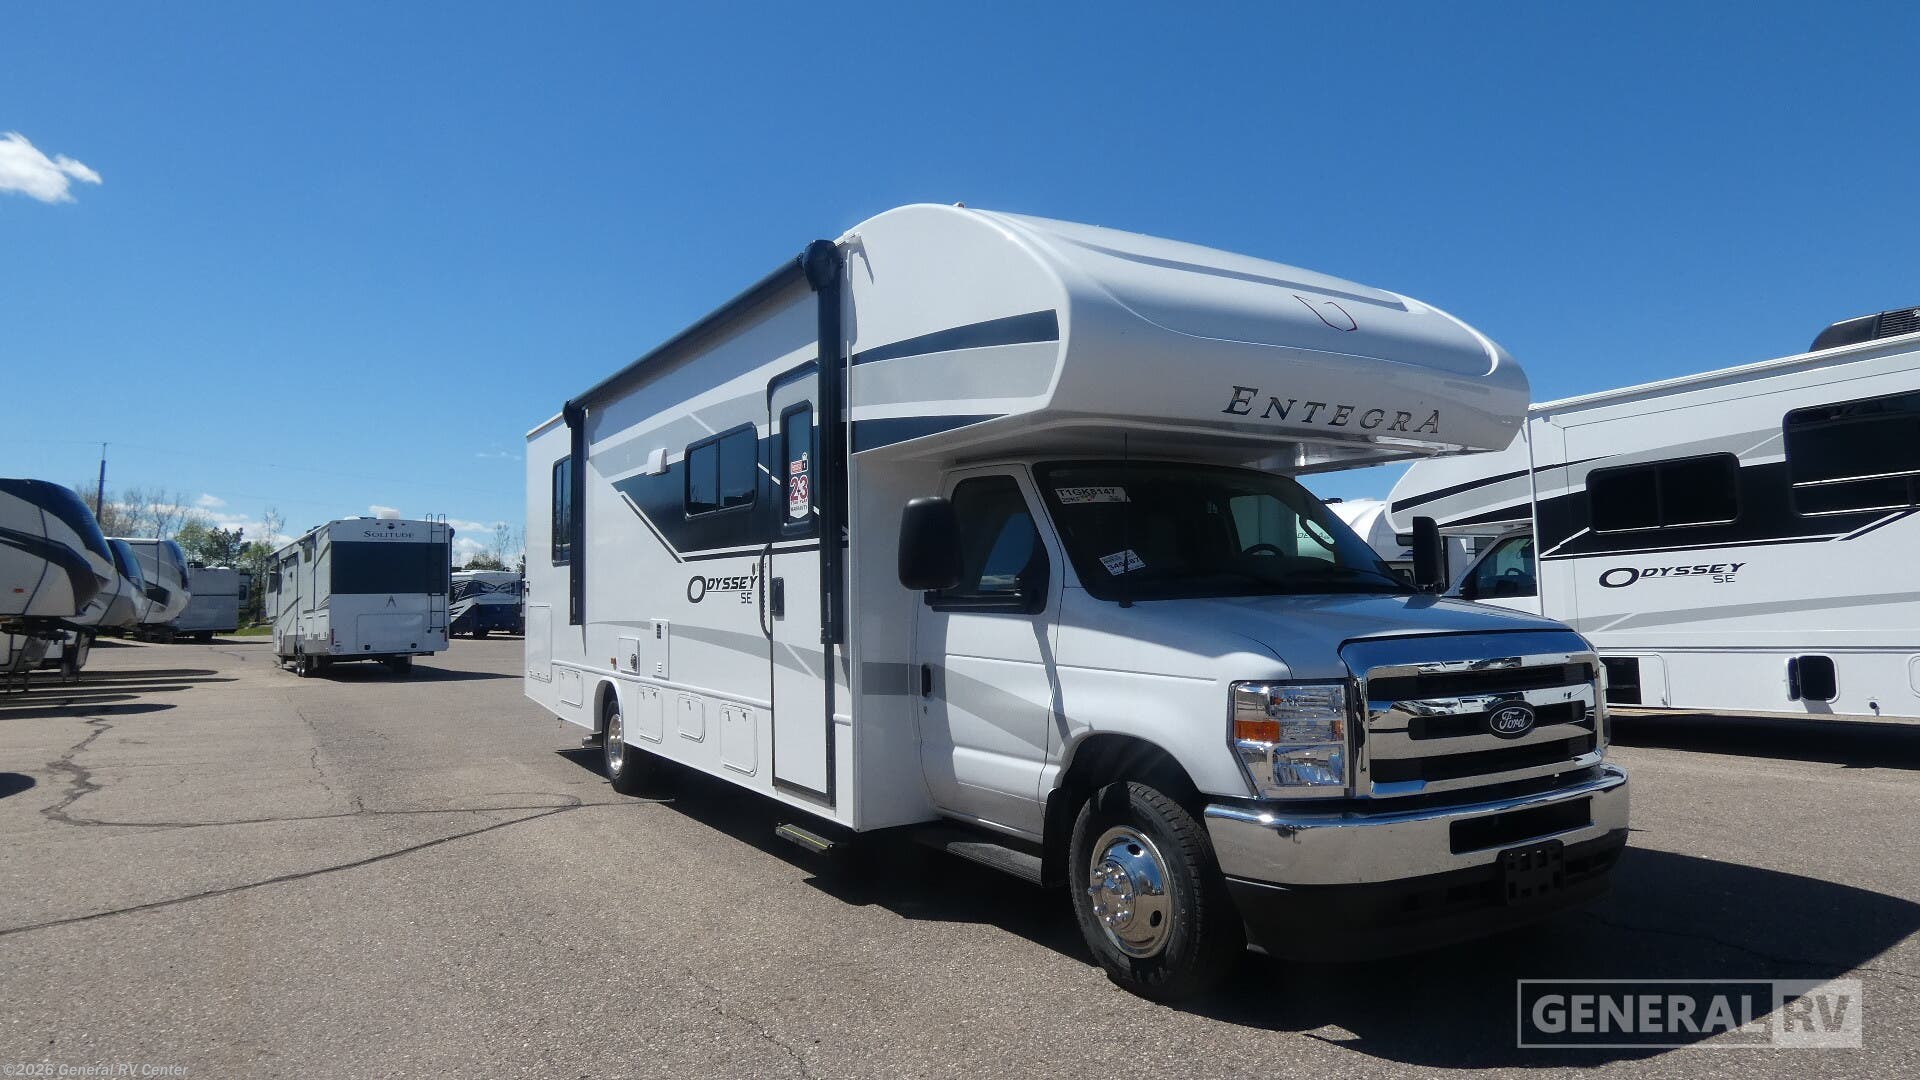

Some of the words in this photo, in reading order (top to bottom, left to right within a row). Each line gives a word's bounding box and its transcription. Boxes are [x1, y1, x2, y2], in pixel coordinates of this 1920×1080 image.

[1221, 385, 1440, 434] ENTEGRA
[363, 530, 415, 539] SOLITUDE
[1598, 562, 1746, 589] ODYSSEY
[1712, 574, 1736, 584] SE
[687, 575, 759, 604] ODYSSEY
[740, 592, 753, 604] SE
[1499, 711, 1526, 730] Ford
